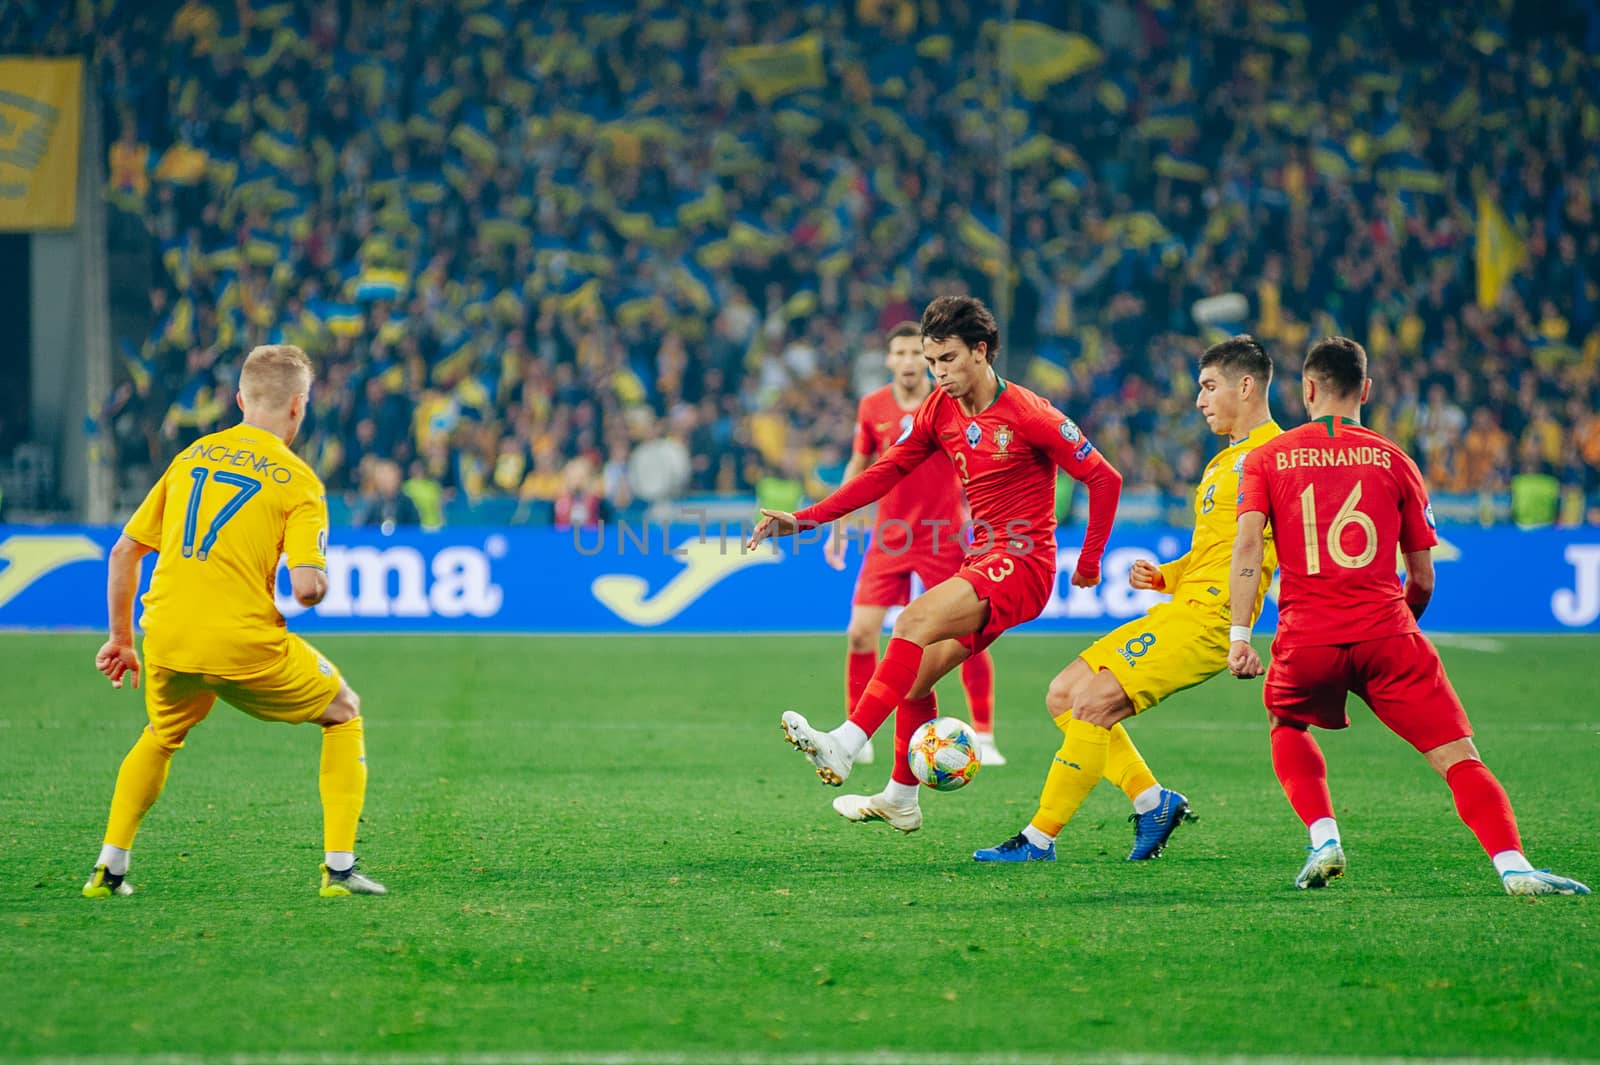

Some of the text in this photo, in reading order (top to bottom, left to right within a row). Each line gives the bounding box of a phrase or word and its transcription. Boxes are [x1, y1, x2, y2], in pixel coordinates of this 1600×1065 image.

[1276, 447, 1391, 471] B.FERNANDES
[1203, 484, 1216, 515] 8
[182, 467, 262, 561] 17
[1300, 480, 1377, 576] 16
[1240, 568, 1254, 577] 23
[1126, 632, 1156, 657] 8
